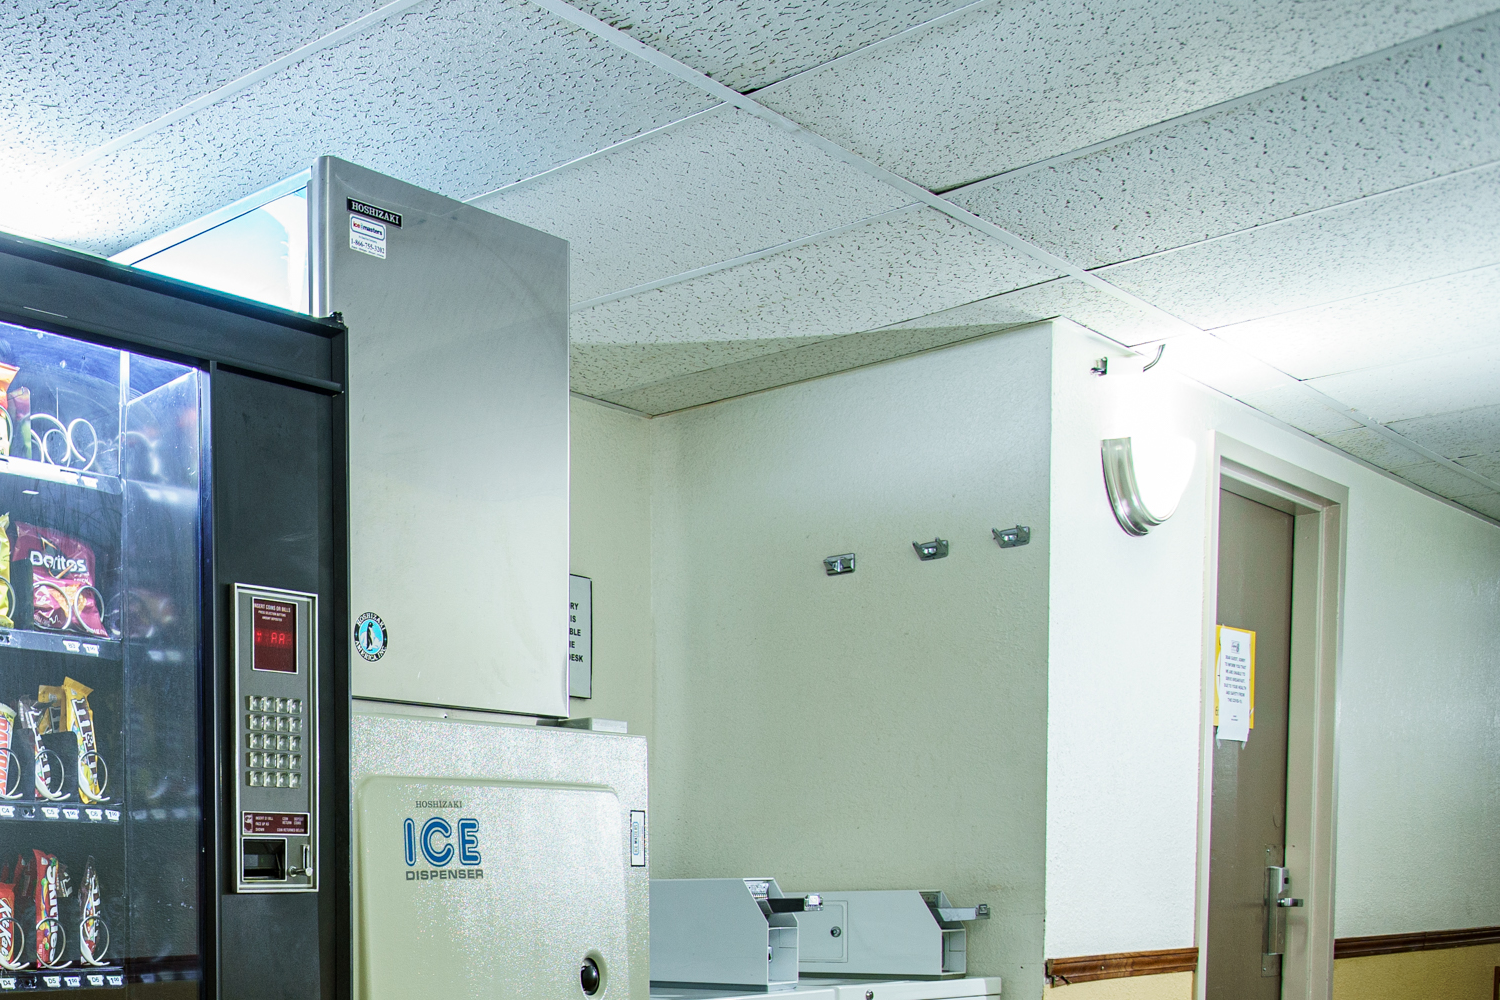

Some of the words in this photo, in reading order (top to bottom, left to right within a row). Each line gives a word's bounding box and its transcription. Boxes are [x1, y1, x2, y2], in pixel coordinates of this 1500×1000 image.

[352, 201, 399, 224] HOSHIZAKI
[29, 550, 88, 573] Doritos
[356, 613, 386, 631] HOSHIZAKI
[415, 800, 463, 809] HOSHIZAKI
[403, 816, 482, 868] ICE
[405, 869, 484, 881] DISPENSER
